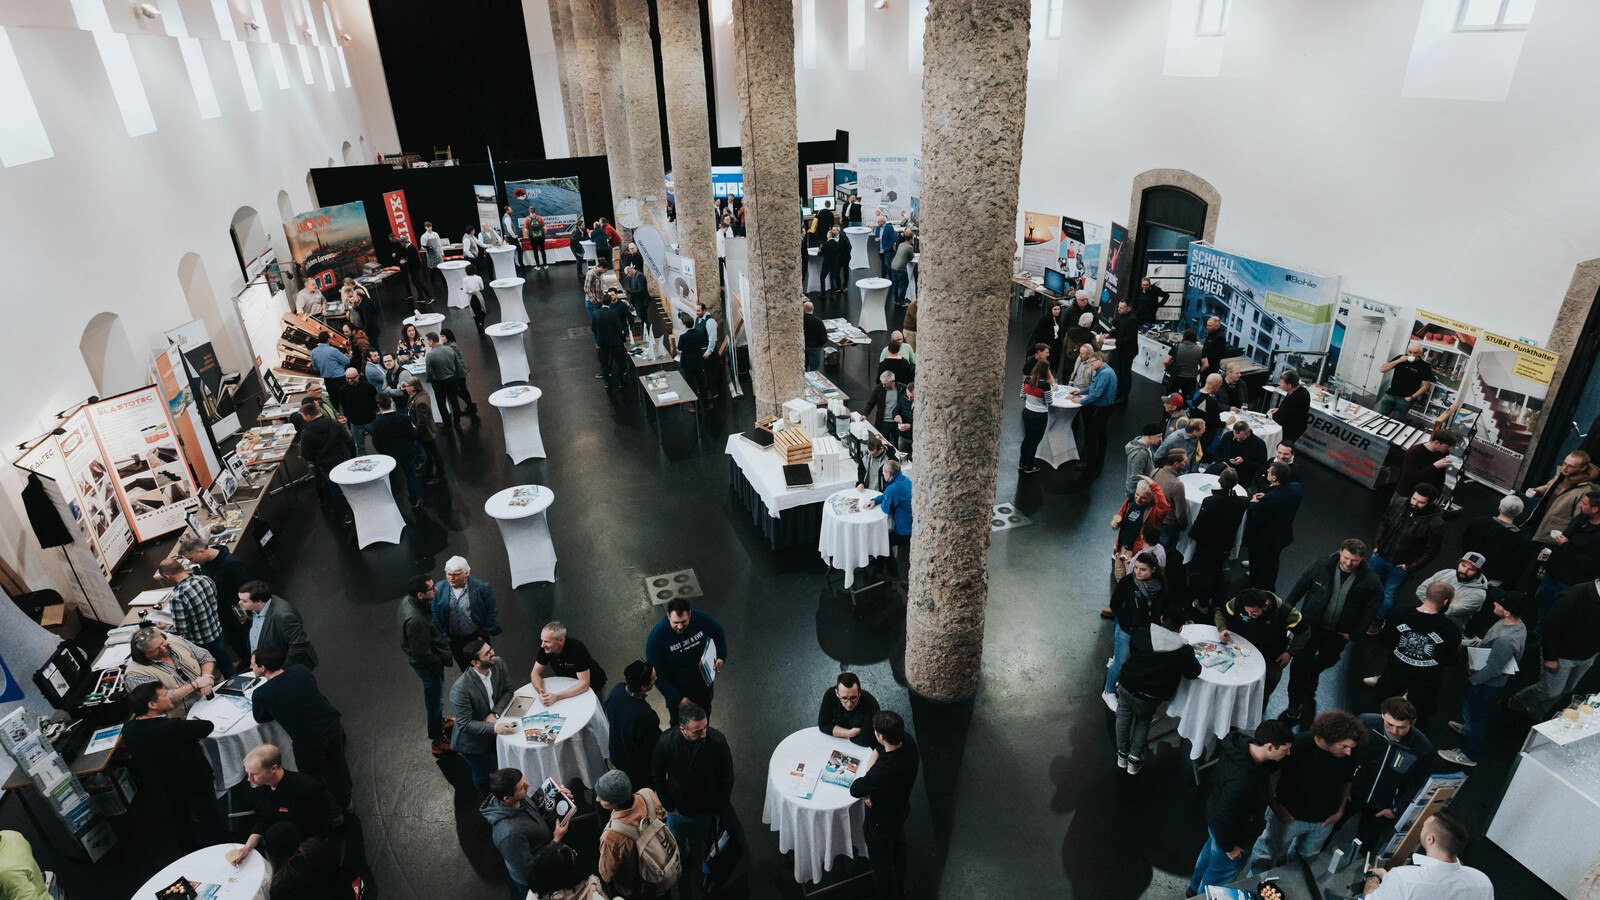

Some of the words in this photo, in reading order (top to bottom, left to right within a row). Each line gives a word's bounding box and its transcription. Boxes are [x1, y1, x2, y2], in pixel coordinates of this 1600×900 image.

[1192, 249, 1238, 273] SCHNELL.
[1189, 275, 1225, 297] SICHER.
[1291, 275, 1317, 289] Bohle
[1485, 335, 1510, 347] STUBAI
[1513, 344, 1555, 362] Punkthalter
[669, 642, 682, 652] BEST
